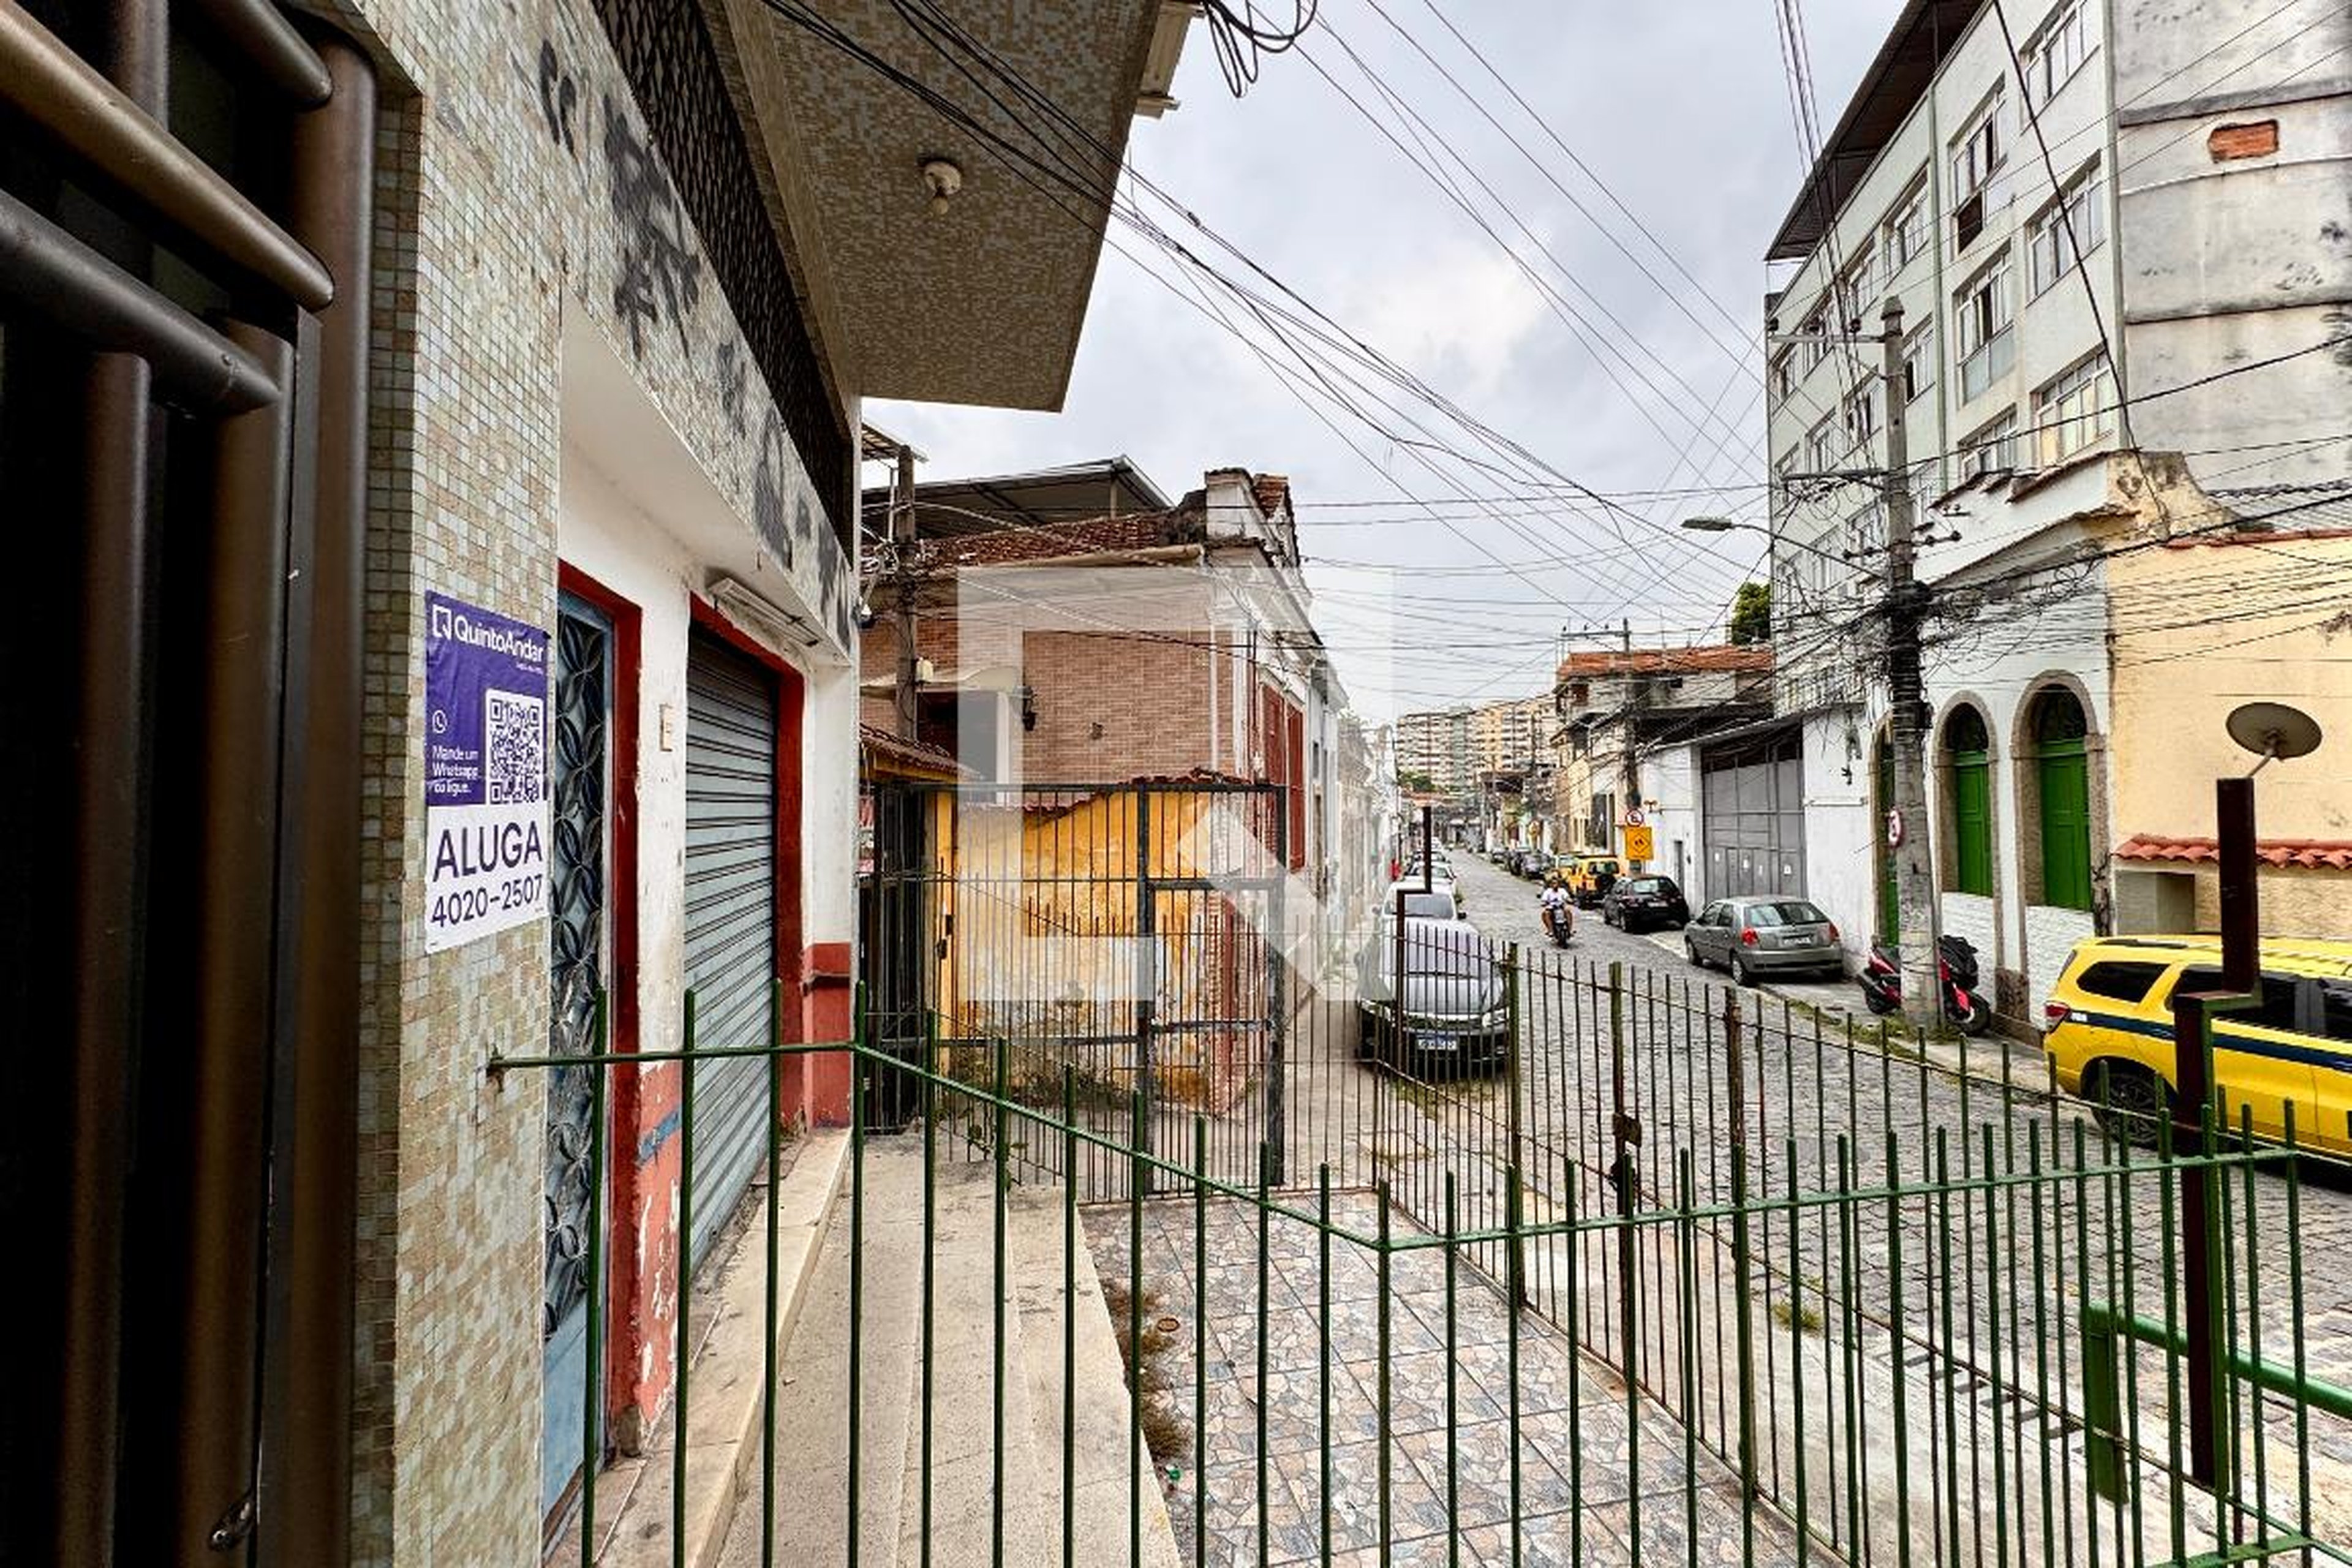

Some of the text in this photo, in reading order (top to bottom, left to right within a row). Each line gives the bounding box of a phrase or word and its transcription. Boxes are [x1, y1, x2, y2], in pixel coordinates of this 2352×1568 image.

[454, 615, 543, 662] QuintoAndar
[432, 745, 464, 760] Mande
[432, 821, 542, 882] ALUGA
[431, 874, 542, 927] 4020-2507
